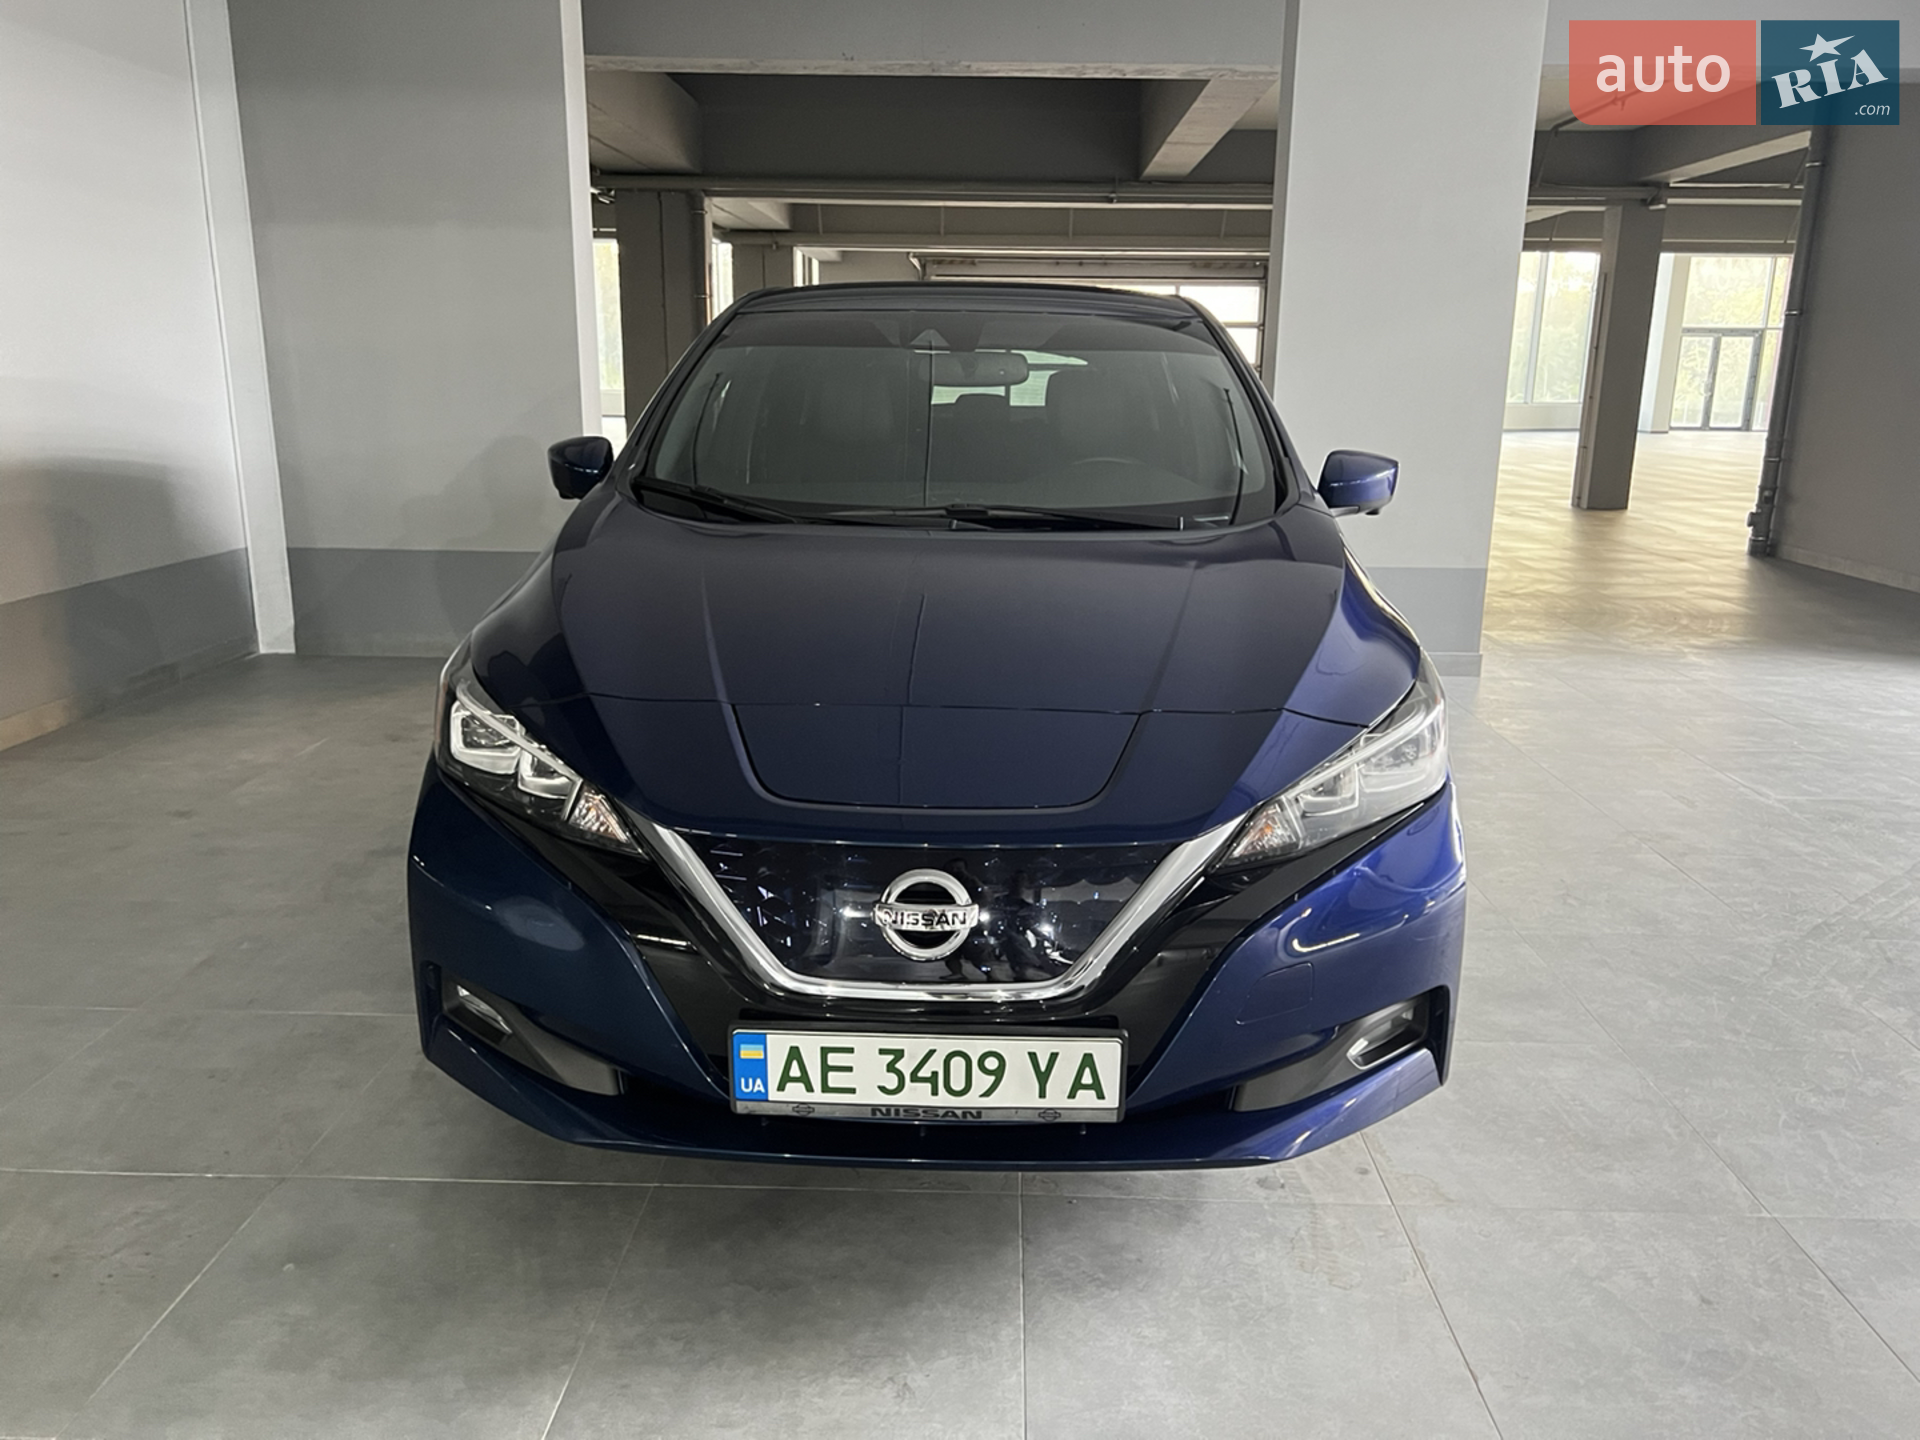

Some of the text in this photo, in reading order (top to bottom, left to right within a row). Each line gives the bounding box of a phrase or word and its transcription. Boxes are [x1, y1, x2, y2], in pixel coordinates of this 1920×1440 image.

[882, 909, 967, 926] NISSAN
[776, 1045, 1106, 1100] AE 3409 YA
[740, 1077, 765, 1094] UA
[870, 1106, 983, 1120] NISSAN
